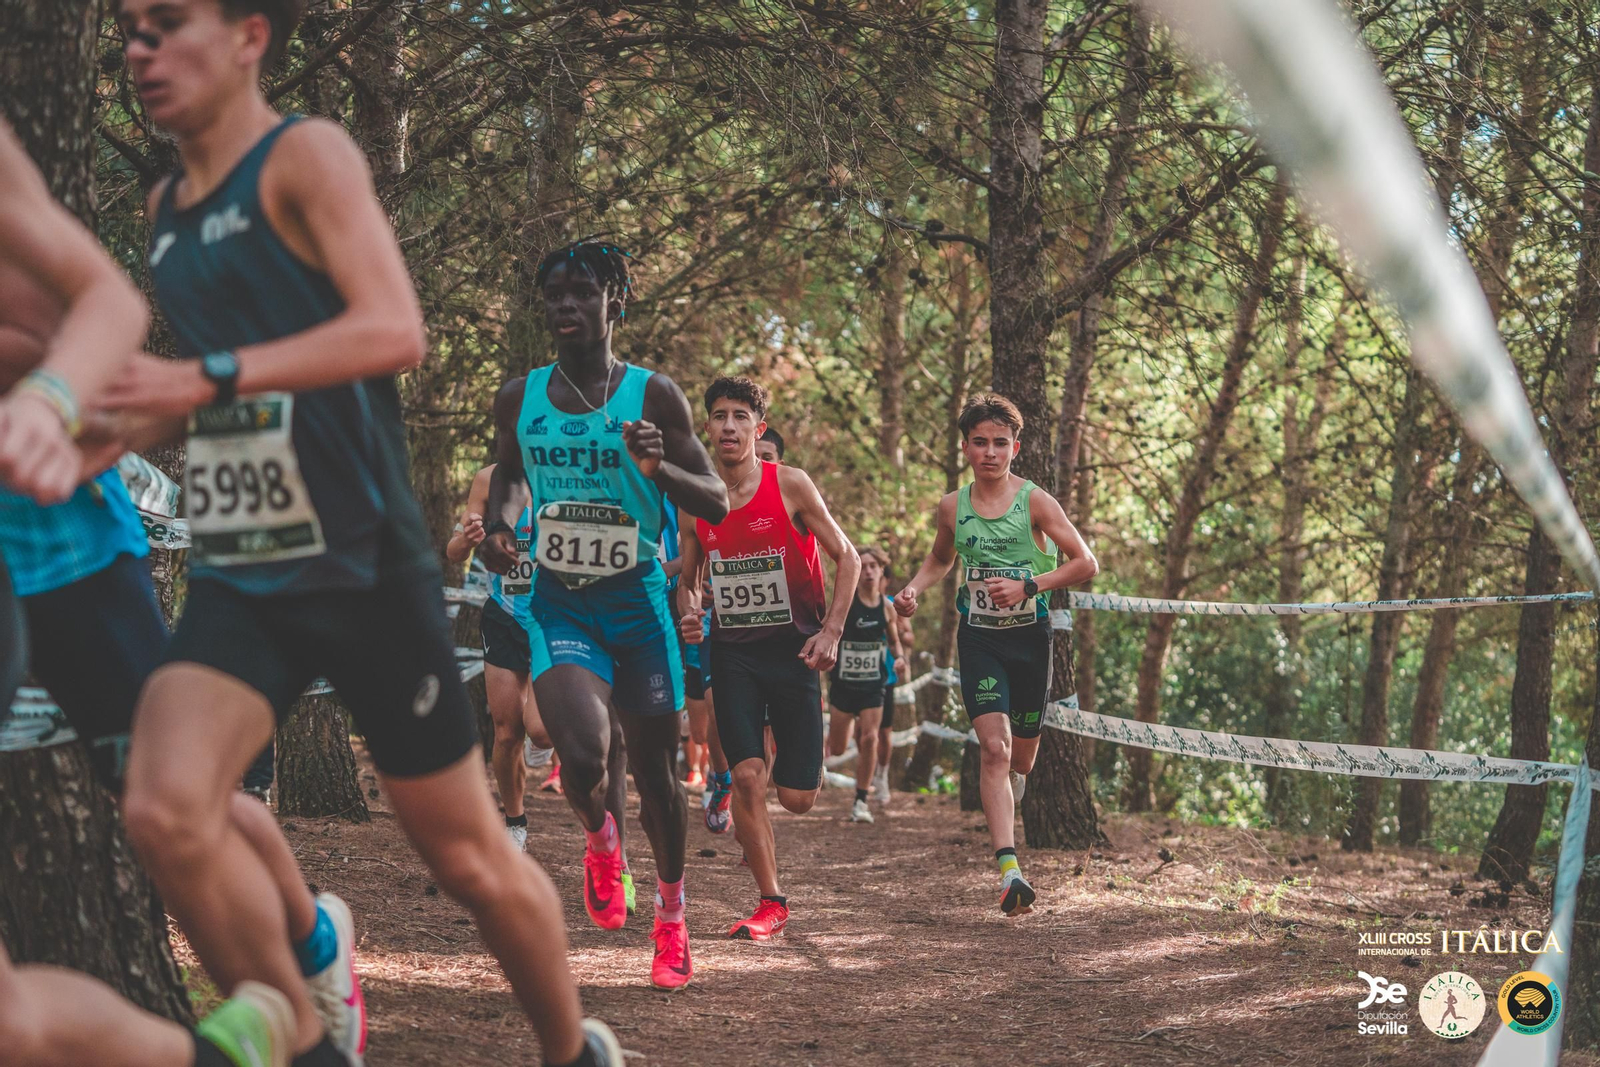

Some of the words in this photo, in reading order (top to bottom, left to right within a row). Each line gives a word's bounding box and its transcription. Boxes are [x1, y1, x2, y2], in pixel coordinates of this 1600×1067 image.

[528, 440, 622, 475] nerja
[190, 459, 292, 518] 5998
[546, 477, 610, 489] ATLETISMO
[565, 506, 613, 519] ITÁLICA
[980, 536, 1018, 545] Fundación
[545, 533, 629, 569] 8116
[980, 544, 1007, 552] Unicaja
[728, 560, 763, 571] ITÁLICA
[983, 569, 1015, 579] ITÁLICA
[720, 582, 784, 609] 5951
[845, 656, 877, 669] 5961
